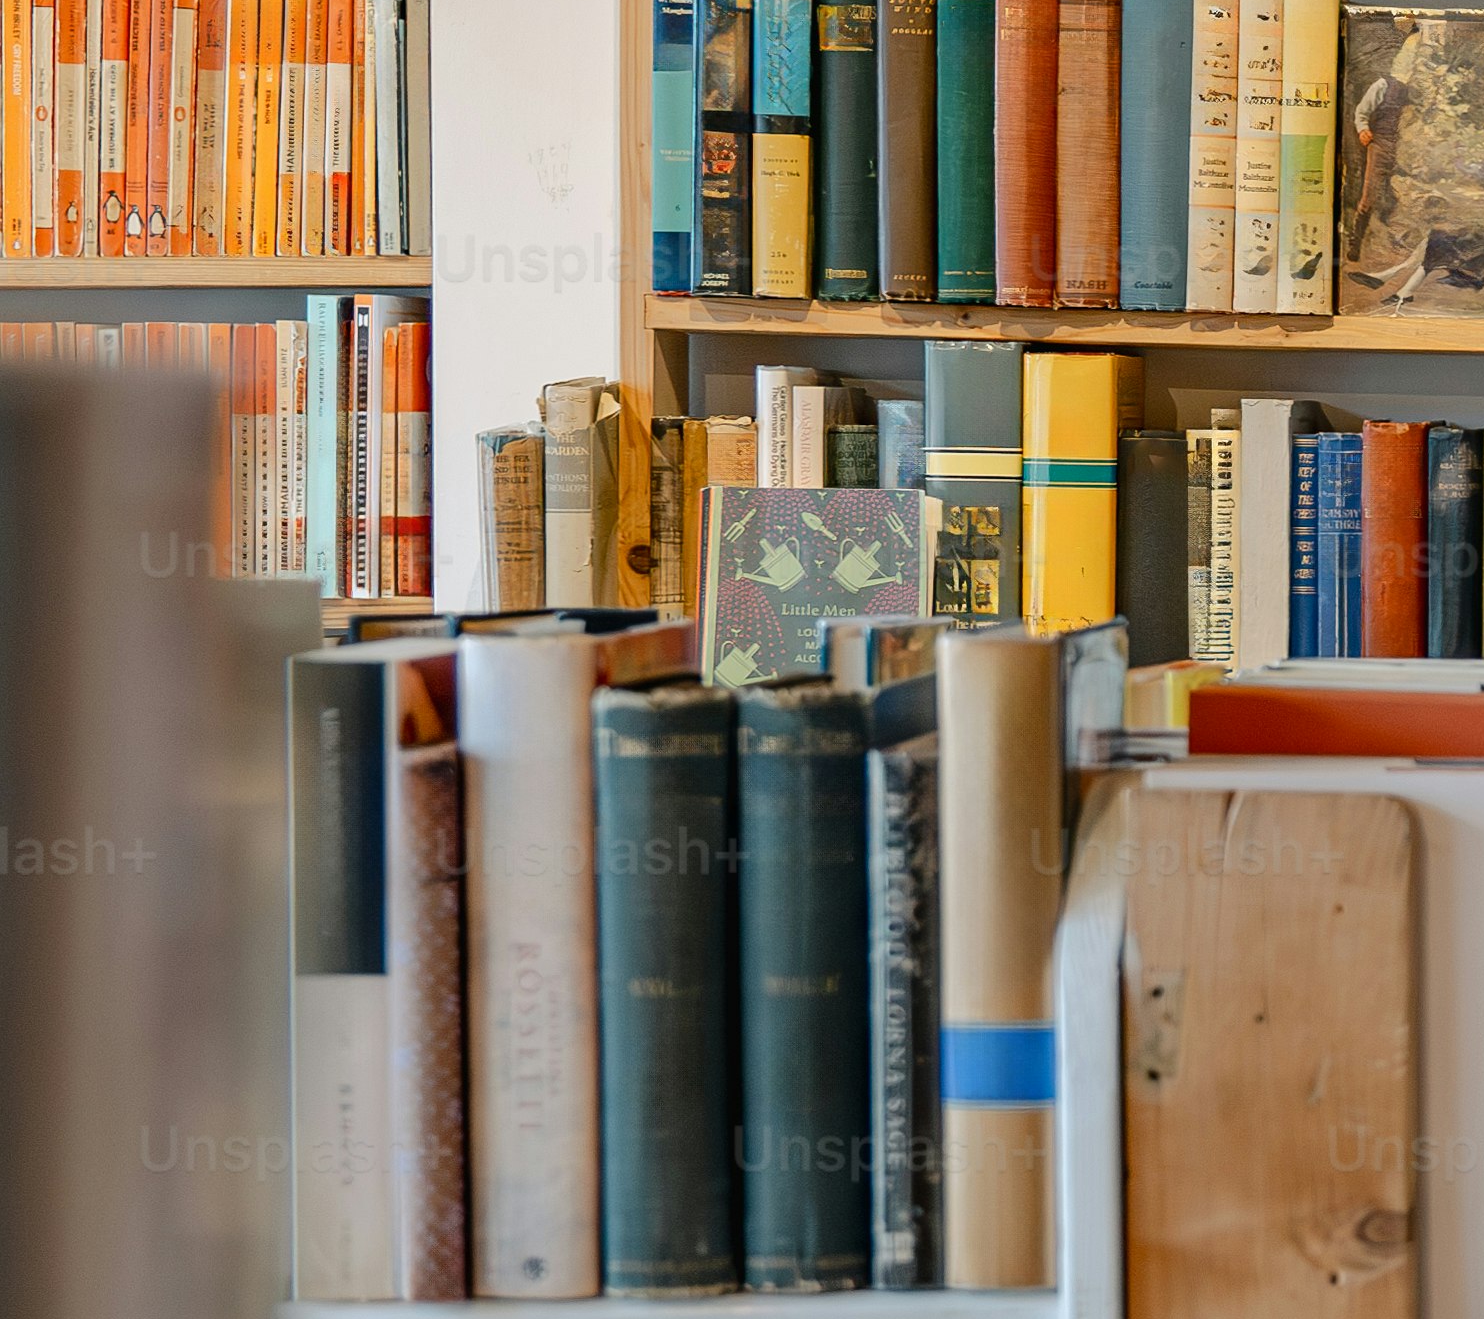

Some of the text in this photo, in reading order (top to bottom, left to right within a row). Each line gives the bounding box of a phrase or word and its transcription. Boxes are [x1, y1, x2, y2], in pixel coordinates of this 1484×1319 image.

[12, 44, 20, 57] CRY
[13, 59, 21, 95] FREEDOM
[88, 125, 96, 142] Ape
[1203, 157, 1227, 167] Justine
[1246, 161, 1272, 171] Justine
[1199, 169, 1230, 178] Balthazar
[1243, 172, 1276, 182] Balthazar
[1065, 280, 1109, 291] NASH
[780, 416, 788, 436] Grass
[800, 400, 812, 451] ALASDAIR
[769, 455, 779, 476] Dying
[1298, 467, 1315, 478] KEY
[1300, 481, 1312, 492] OF
[781, 602, 856, 617] Little Men
[887, 987, 907, 1172] LORNA SAGE
